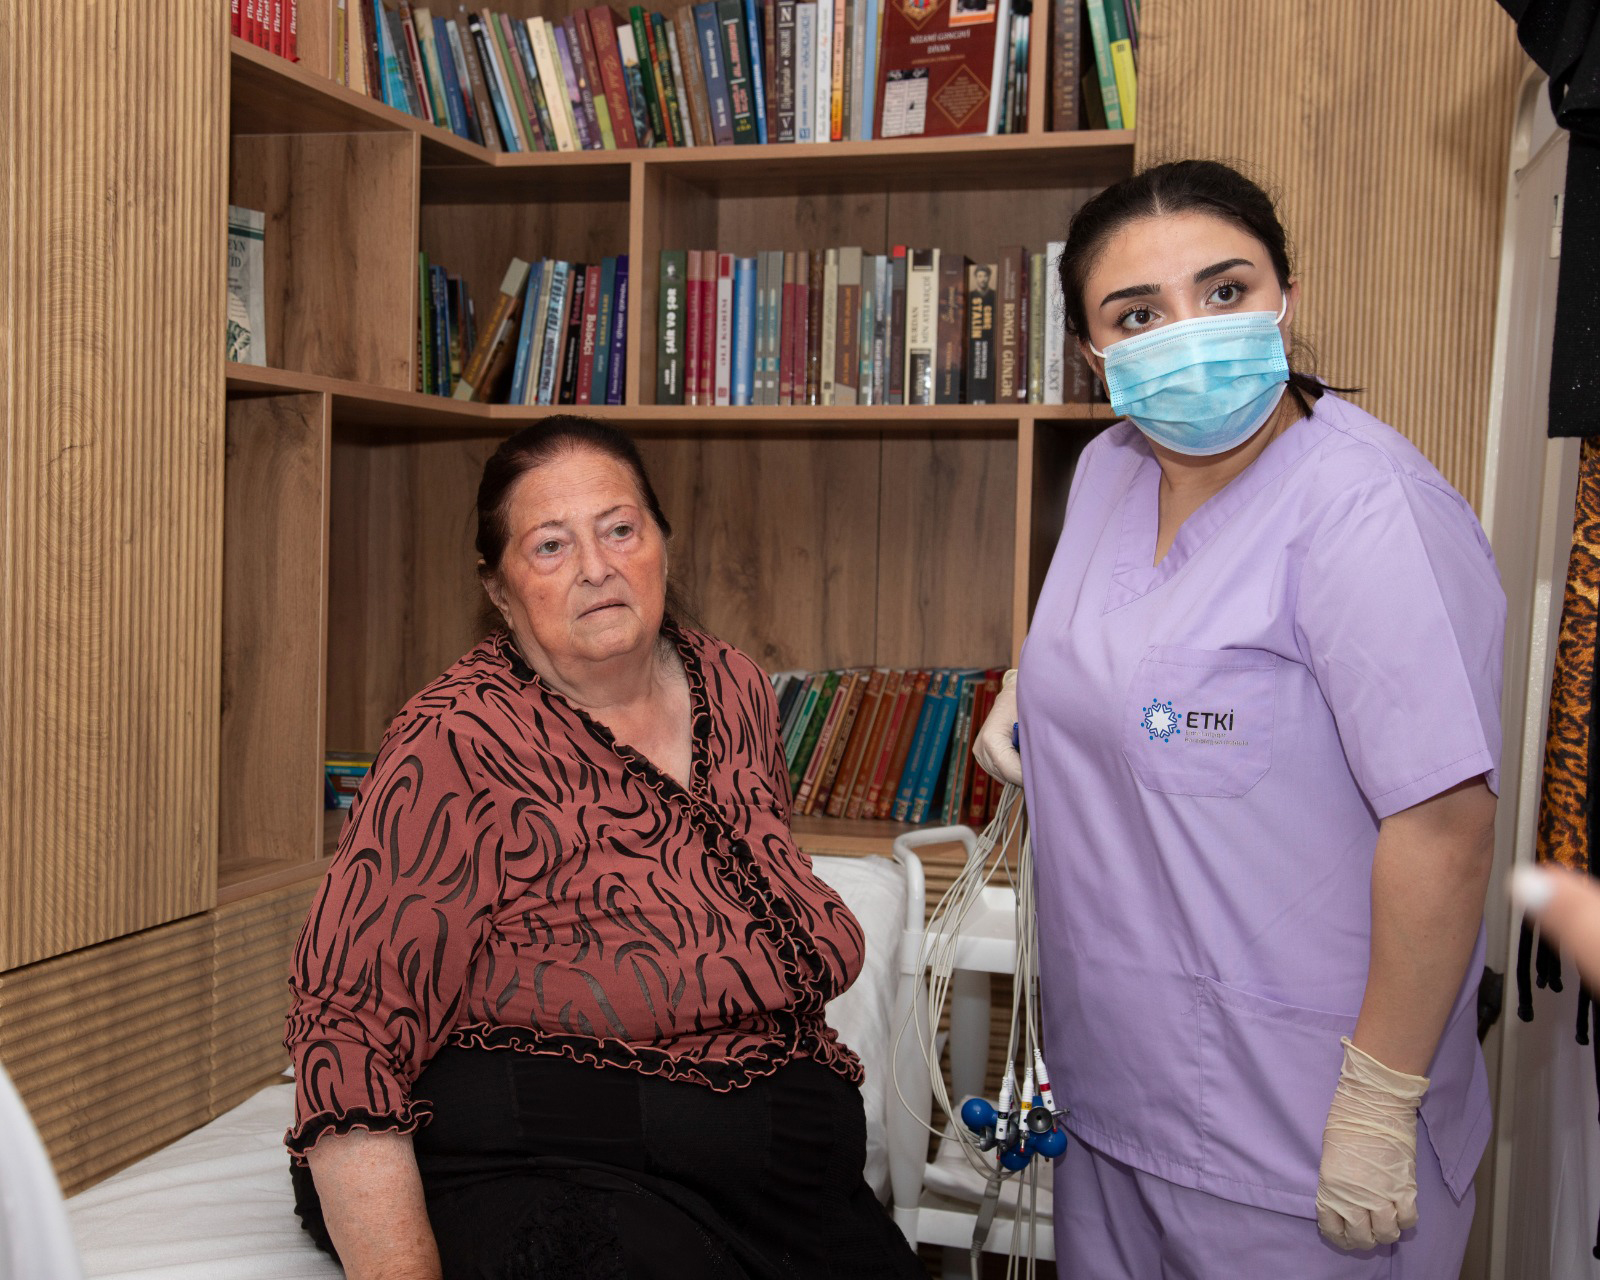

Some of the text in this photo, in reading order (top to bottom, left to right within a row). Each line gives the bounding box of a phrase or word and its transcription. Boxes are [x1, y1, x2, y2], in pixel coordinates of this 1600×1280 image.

[664, 288, 679, 355] ŞAİR VƏ ŞƏR
[971, 297, 983, 339] STALİN
[1001, 303, 1016, 398] RƏNGLİ GÜNLƏR
[1186, 709, 1234, 733] ETKİ
